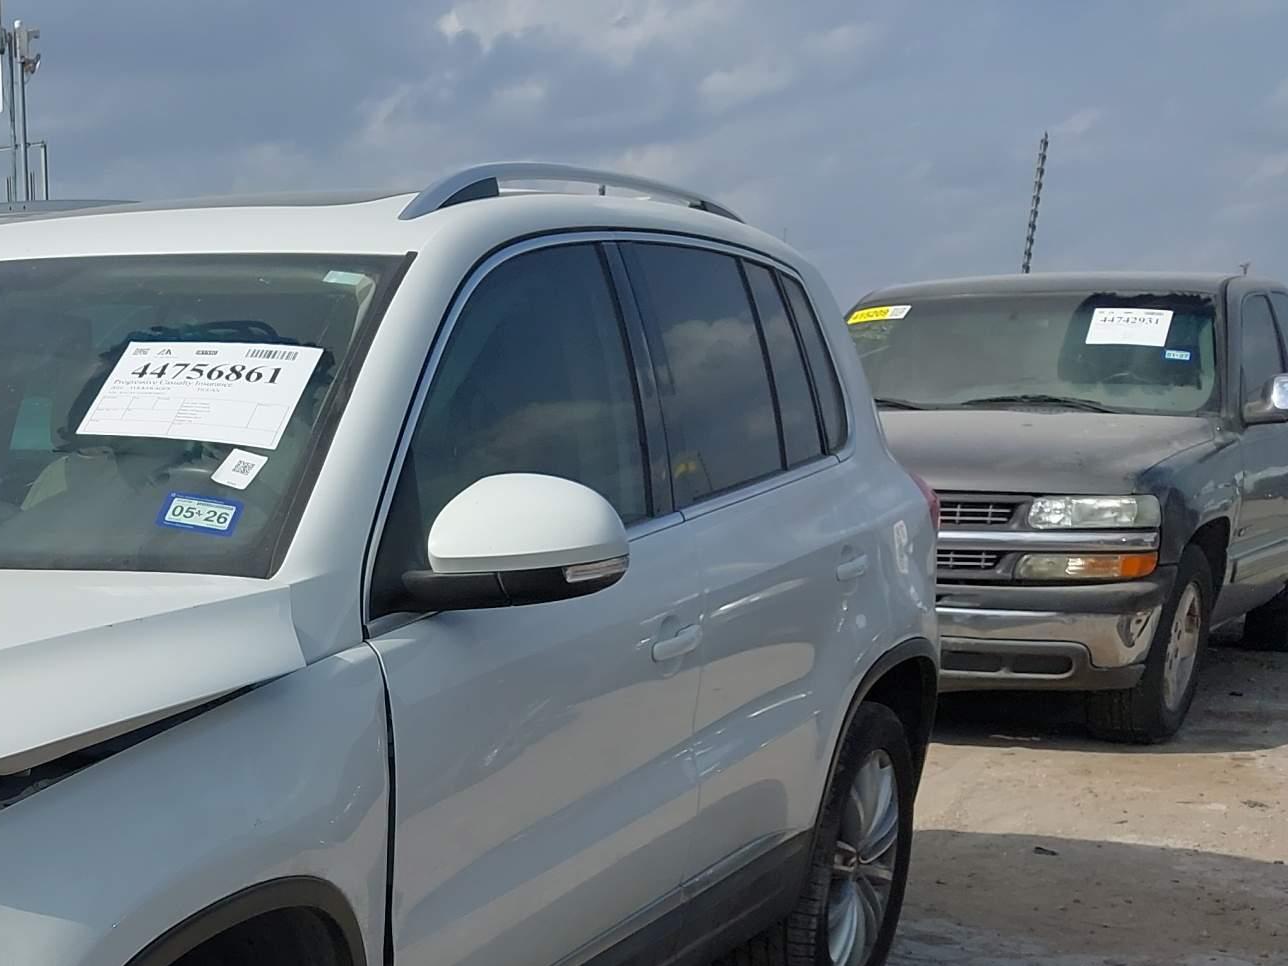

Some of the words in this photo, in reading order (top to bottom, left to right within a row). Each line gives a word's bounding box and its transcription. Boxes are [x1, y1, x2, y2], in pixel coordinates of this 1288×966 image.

[131, 362, 282, 385] 44756861
[172, 505, 196, 519] 05
[203, 510, 230, 524] 26
